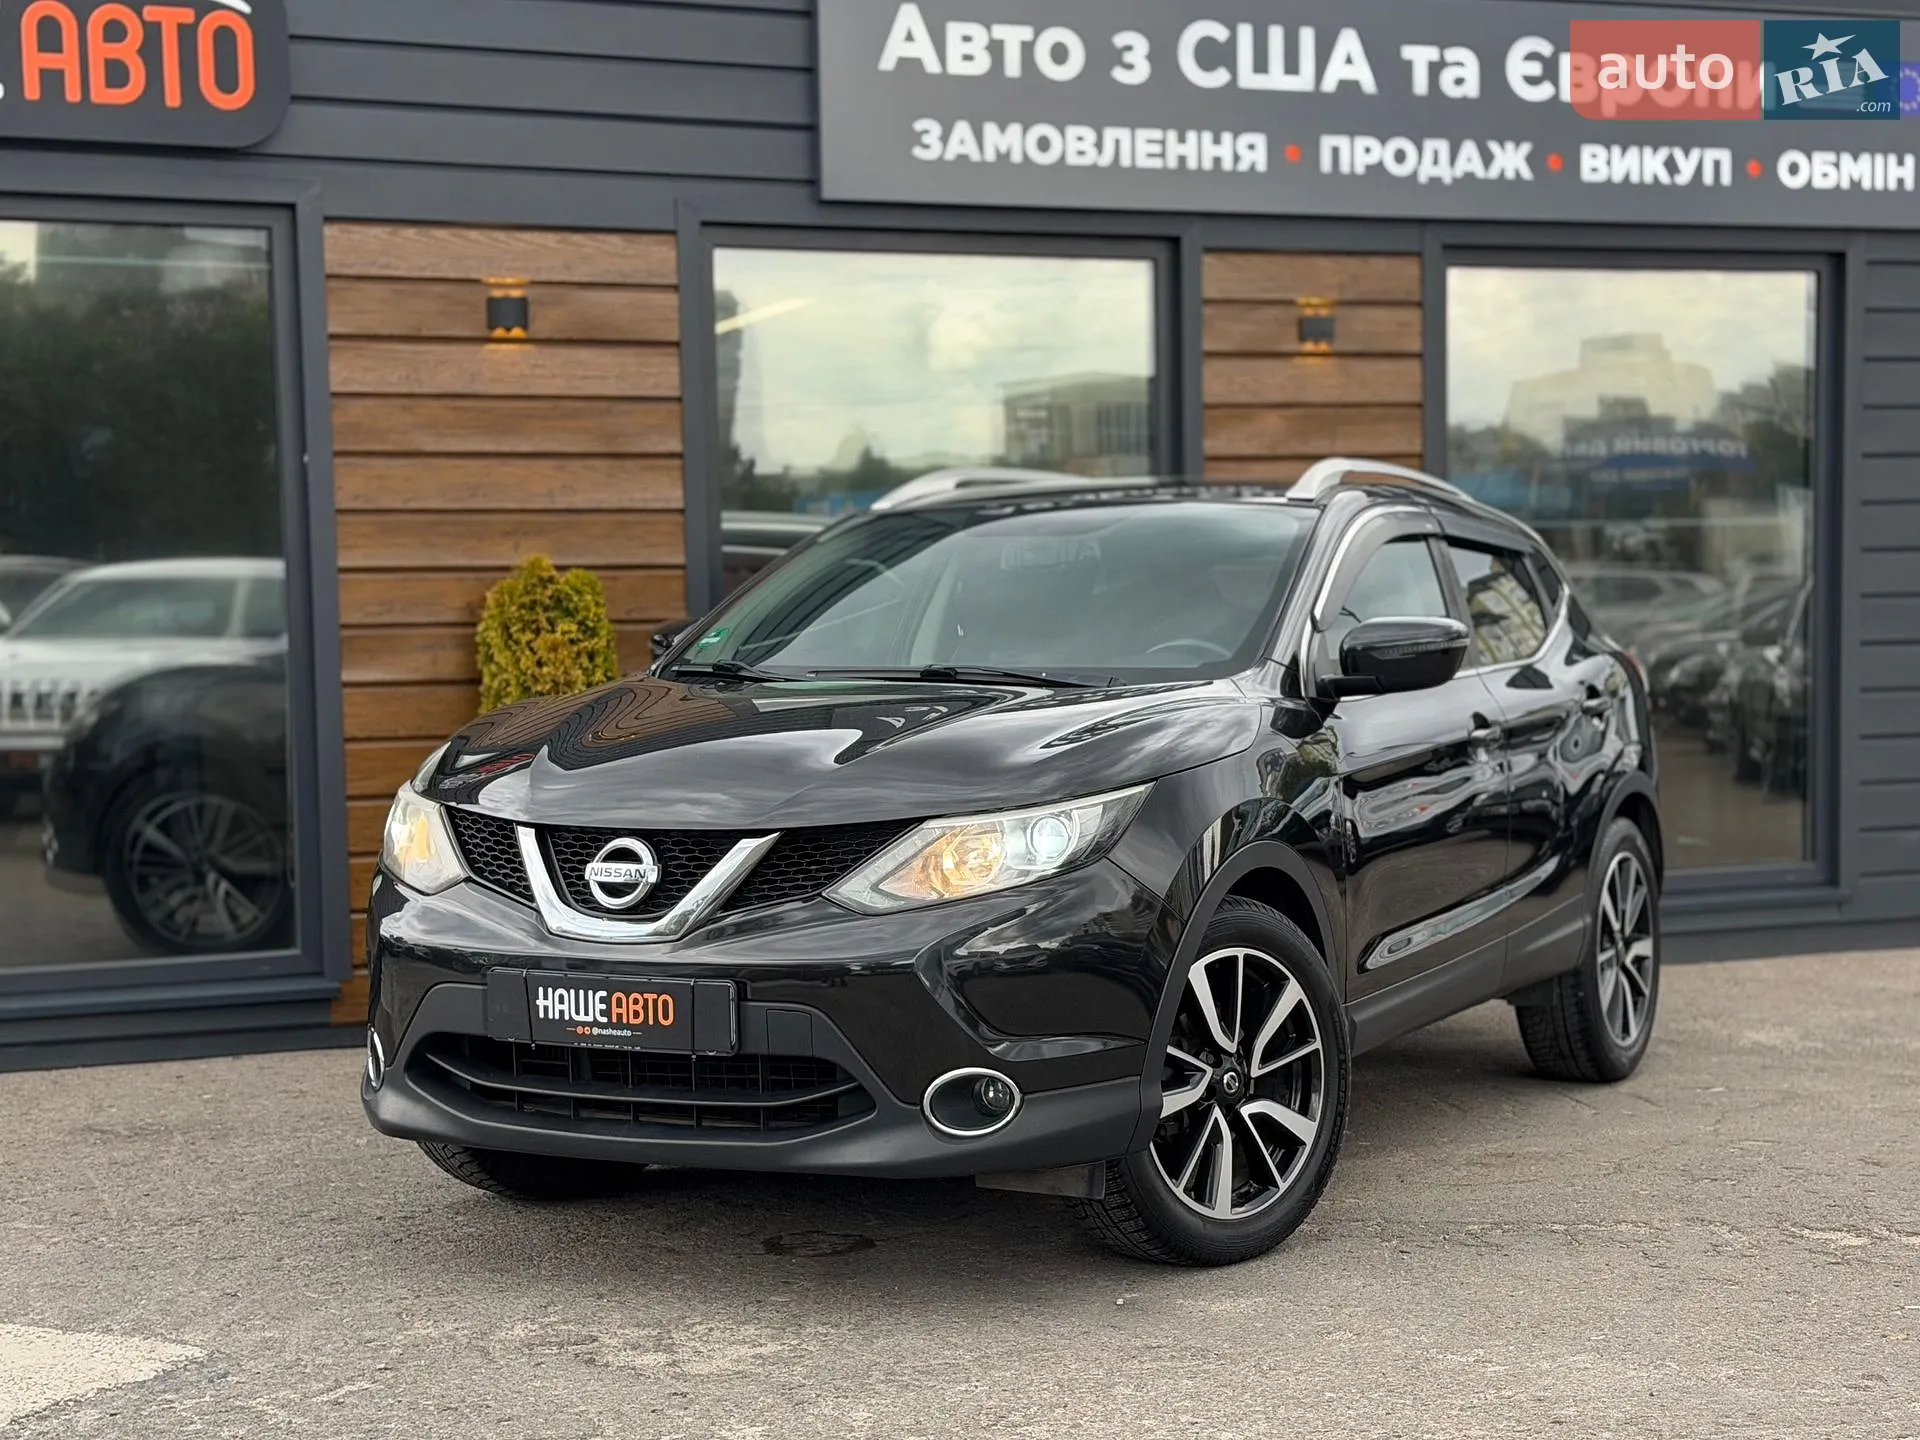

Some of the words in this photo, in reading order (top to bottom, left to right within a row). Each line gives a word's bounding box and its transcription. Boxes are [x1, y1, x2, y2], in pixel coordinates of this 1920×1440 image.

[21, 0, 256, 111] АВТО
[877, 2, 1086, 82] Авто
[1110, 30, 1152, 86] з
[1177, 19, 1378, 95] США
[1400, 44, 1480, 99] та
[911, 117, 1268, 173] ЗАМОВЛЕННЯ
[1319, 134, 1534, 185] ПРОДАЖ
[1579, 143, 1733, 187] ВИКУП
[1776, 149, 1916, 192] ОБМІН
[589, 867, 646, 879] NISSAN
[535, 986, 608, 1023] НАШЕ
[611, 991, 675, 1027] АВТО
[591, 1027, 632, 1037] @nasheauto
